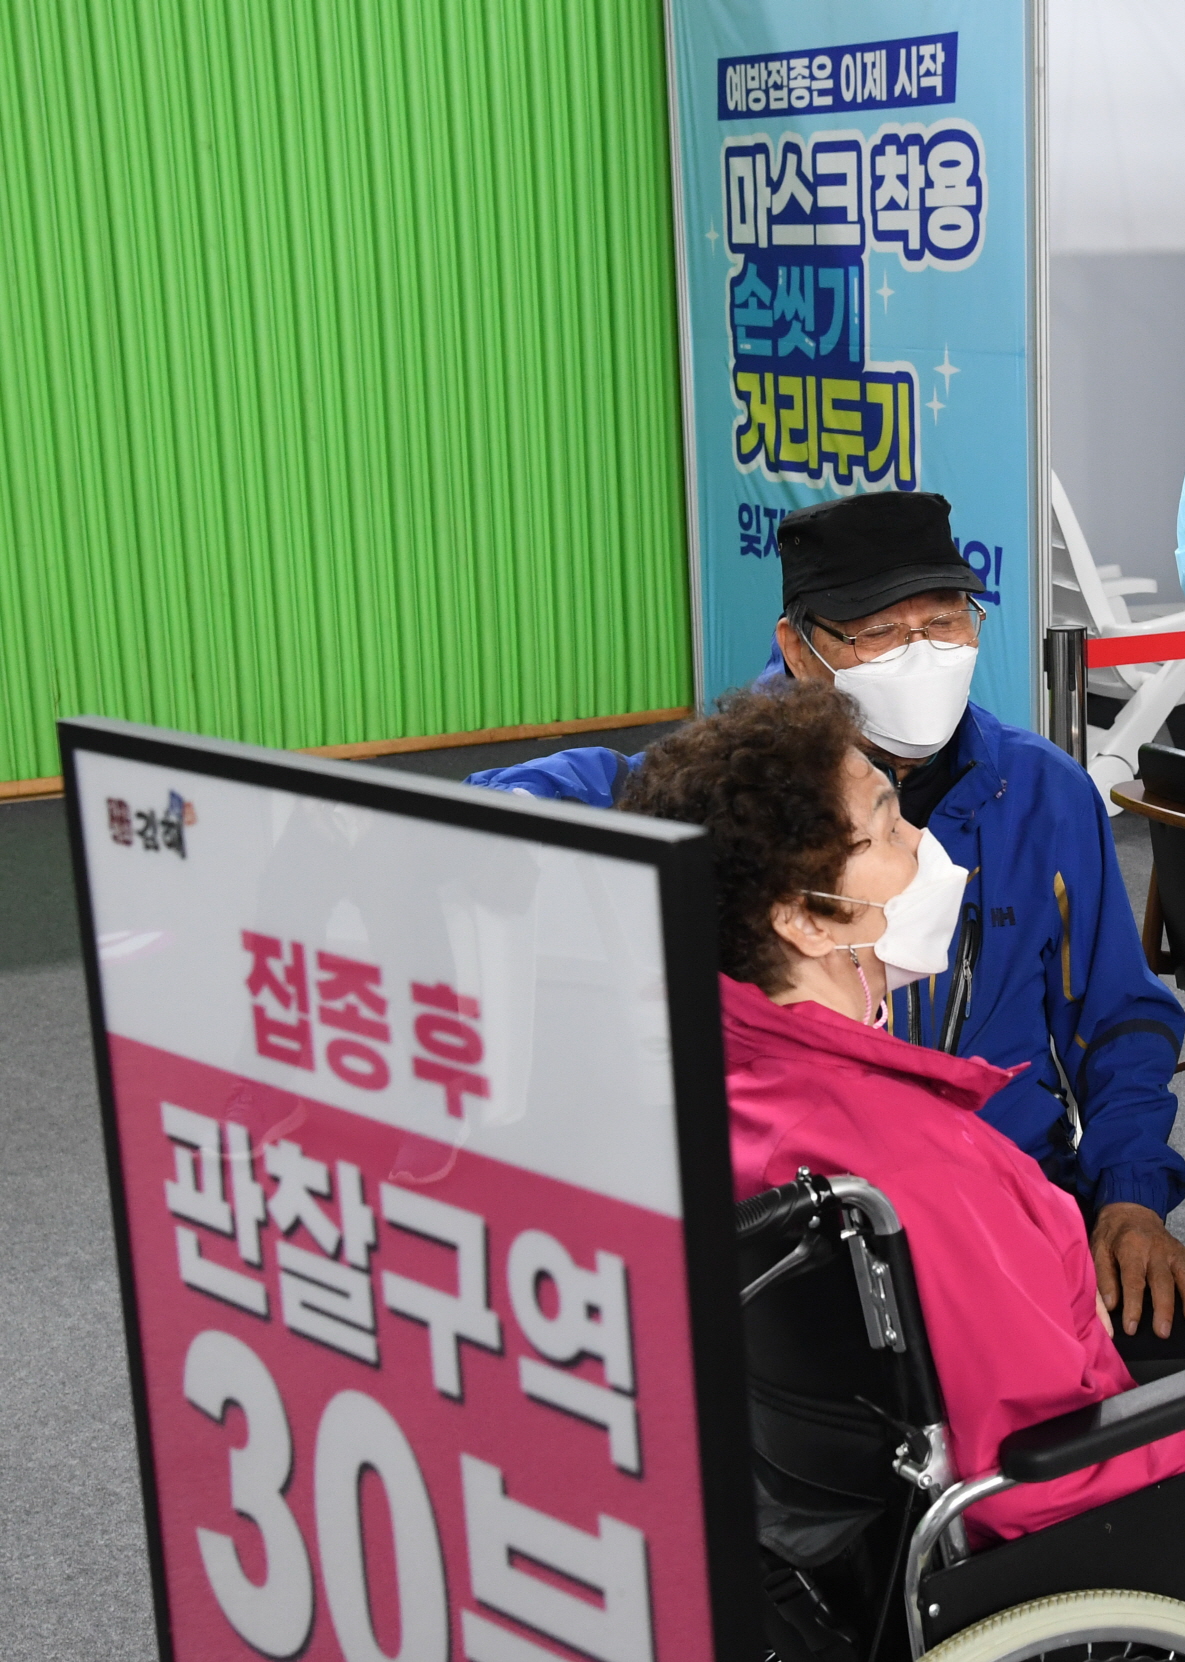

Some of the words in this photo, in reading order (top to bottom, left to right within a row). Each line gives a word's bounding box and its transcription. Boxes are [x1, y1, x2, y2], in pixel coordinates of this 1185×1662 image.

[726, 55, 834, 112] 예방접종은
[840, 50, 887, 103] 이제
[893, 44, 946, 100] 시작
[728, 148, 863, 251] 마스크
[874, 138, 979, 253] 착용
[732, 262, 861, 363] 손씻기
[736, 370, 913, 483] 거리두기
[240, 929, 392, 1093] 접종
[409, 978, 491, 1119] 후
[160, 1100, 644, 1478] 관찰구역
